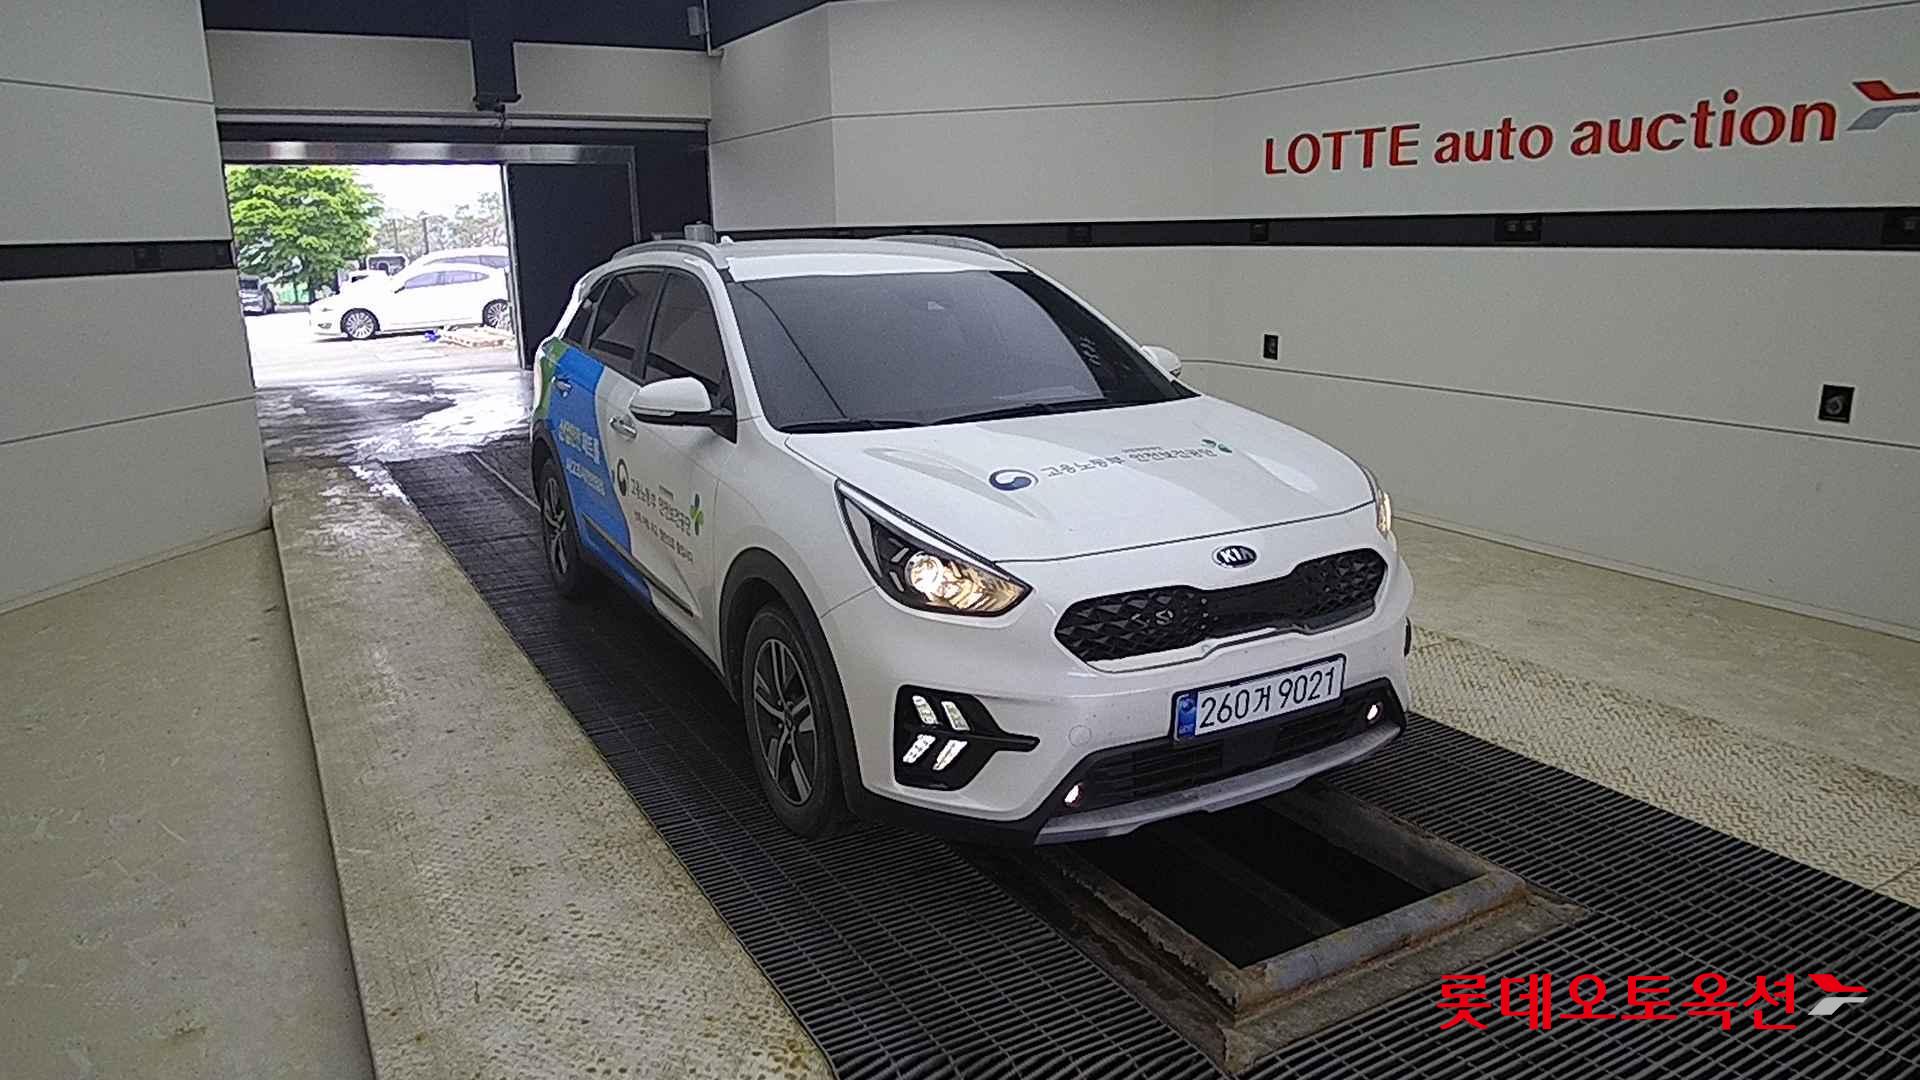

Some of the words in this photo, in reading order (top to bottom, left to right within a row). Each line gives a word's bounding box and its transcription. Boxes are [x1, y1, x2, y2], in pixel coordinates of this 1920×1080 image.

[1264, 122, 1422, 175] LOTTE
[1432, 116, 1554, 165] auto
[1570, 87, 1838, 158] auction
[1041, 455, 1126, 478] 고용노동부
[1219, 547, 1254, 563] KIA
[1199, 685, 1271, 729] 260거
[1278, 666, 1336, 709] 9021
